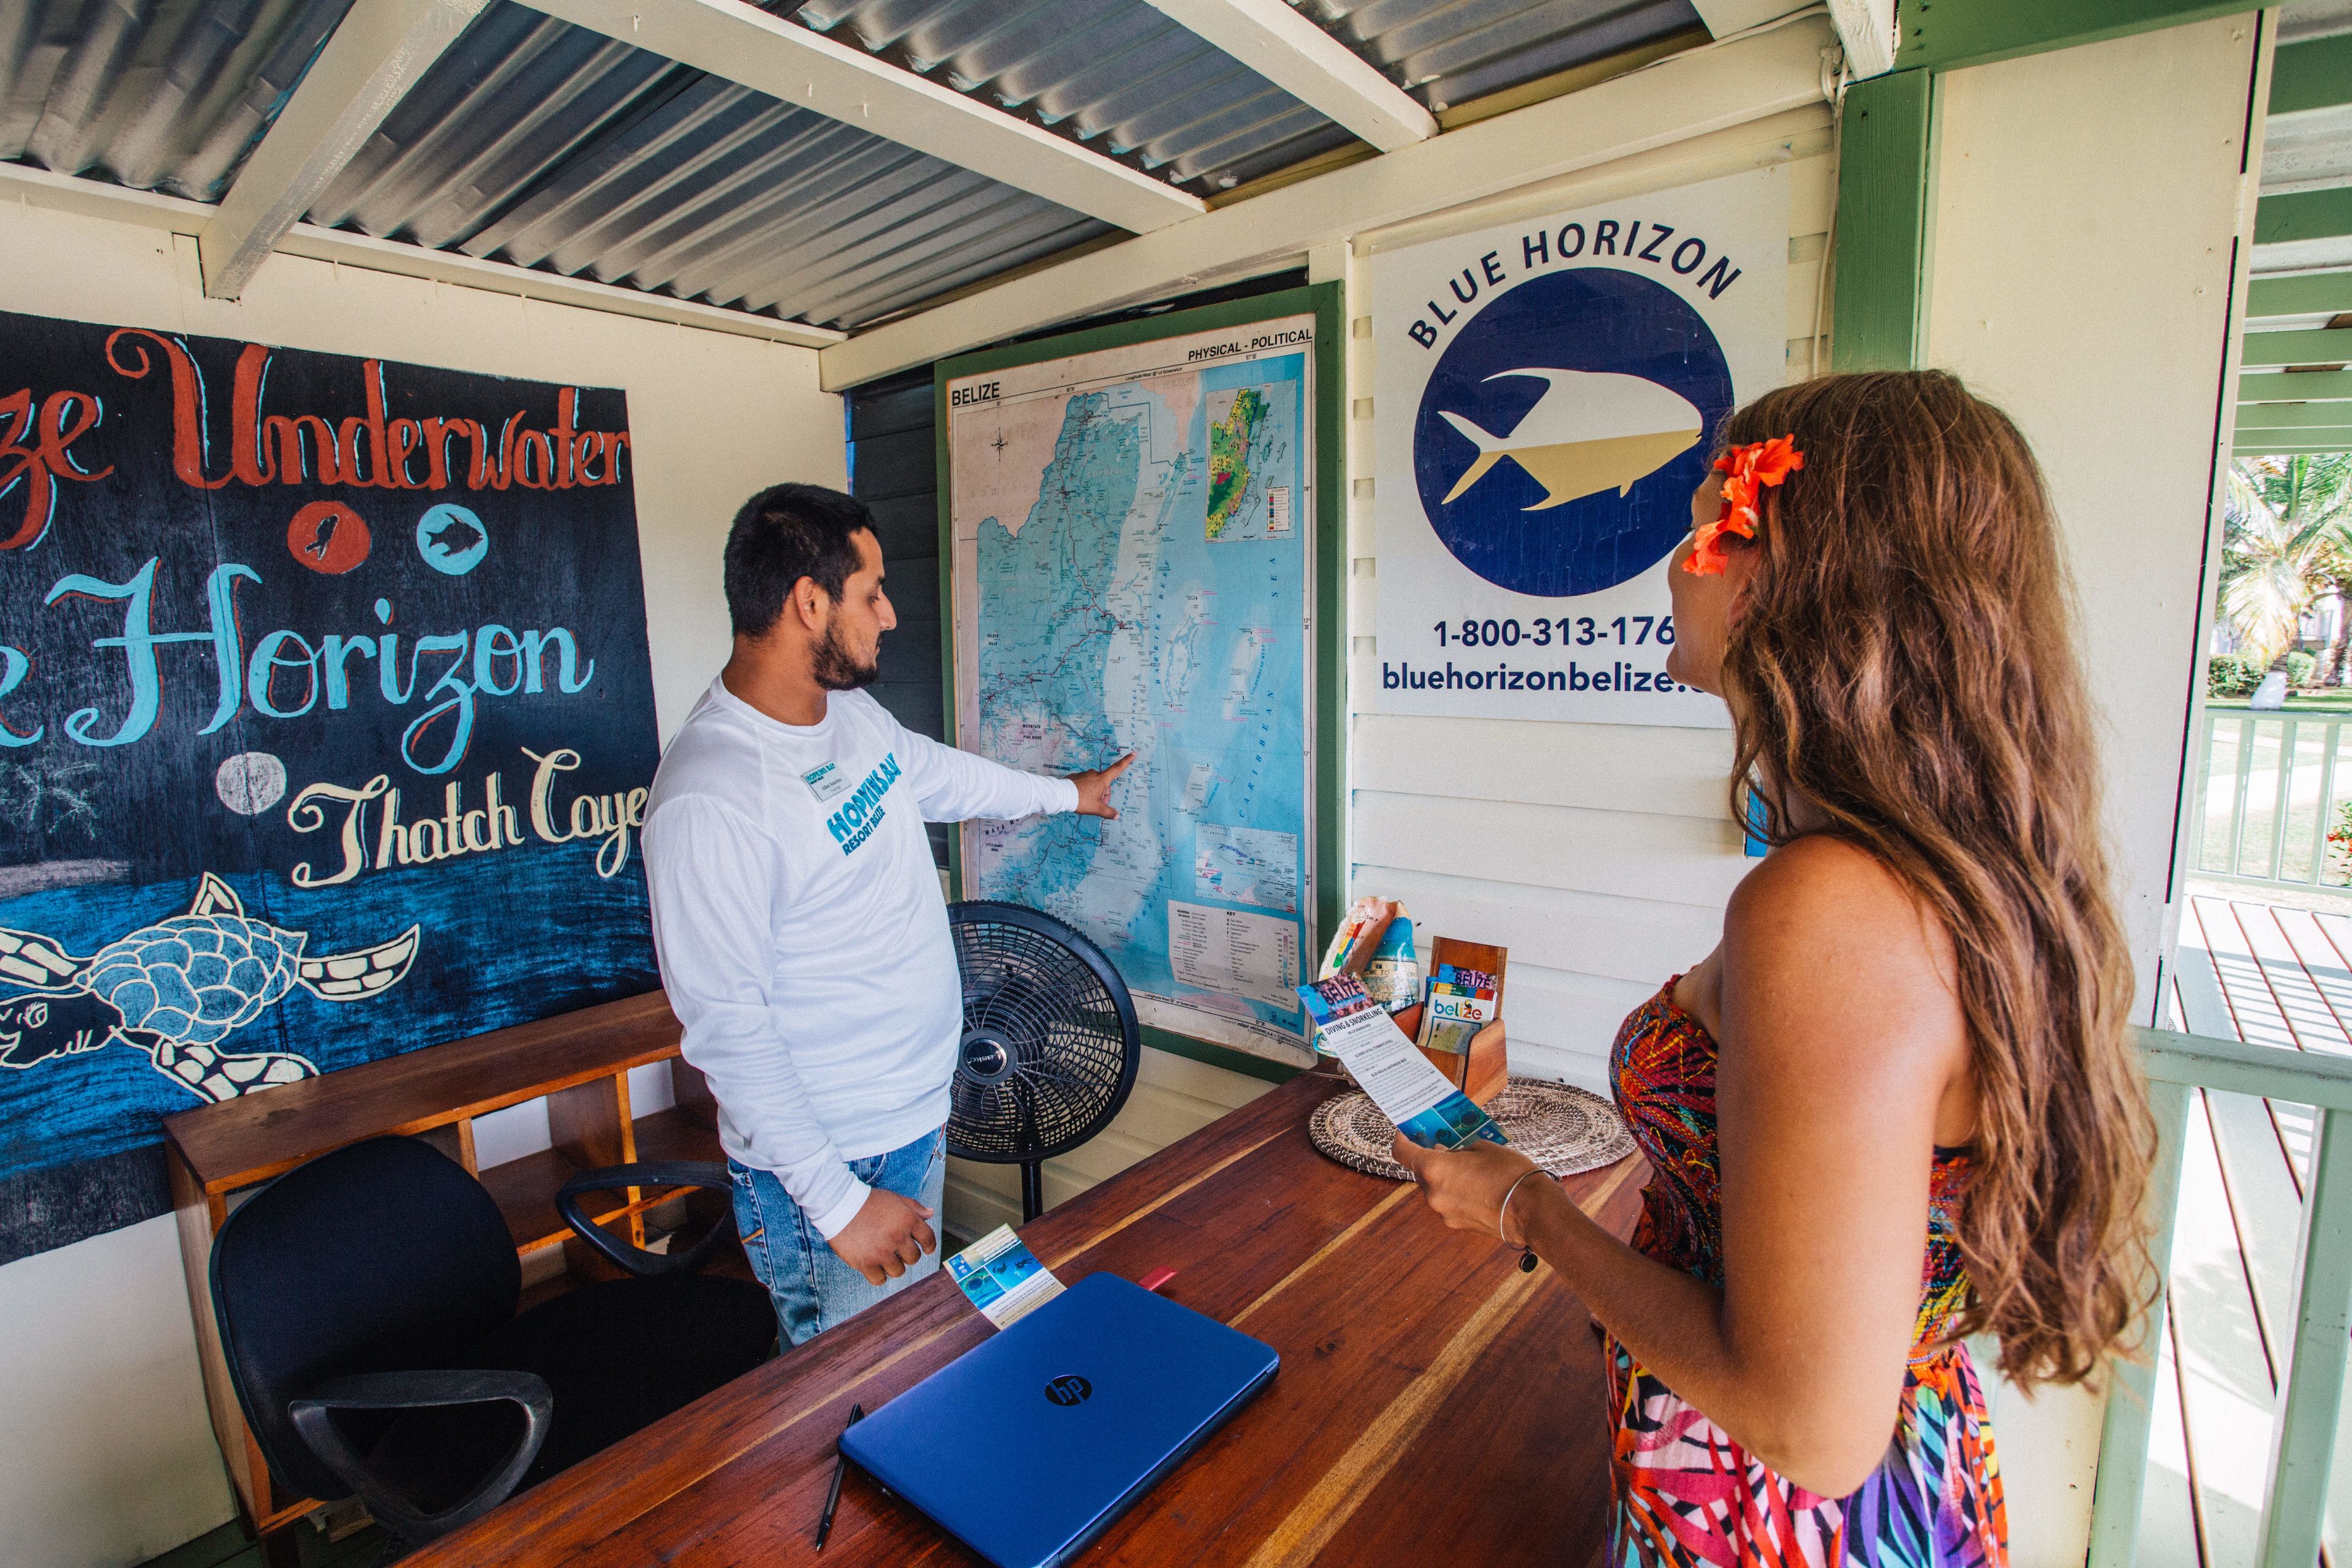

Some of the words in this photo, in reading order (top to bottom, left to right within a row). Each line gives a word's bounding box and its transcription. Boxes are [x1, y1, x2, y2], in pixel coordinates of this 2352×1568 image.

[1408, 251, 1506, 350] BLUE
[1522, 219, 1742, 300] HORIZON
[1188, 343, 1242, 361] PHYSICAL
[1251, 329, 1313, 349] POLITICAL
[105, 328, 630, 490] Underwater
[952, 382, 1000, 406] BELIZE
[45, 556, 594, 774] Horizon
[1382, 662, 1706, 693] bluehorizonbelize.
[1238, 690, 1275, 819] CARIBBEAN
[1268, 557, 1279, 598] SEA
[288, 774, 521, 888] Thatch
[521, 746, 647, 878] Caye
[826, 769, 889, 843] HOPKINS
[878, 752, 902, 785] BAY
[842, 821, 874, 856] RESORT
[871, 805, 886, 829] BELIZE
[1320, 980, 1365, 1005] BELIZE
[1434, 999, 1482, 1020] belize
[1325, 1022, 1346, 1035] DIVING
[1349, 1008, 1383, 1025] SNORKELING
[1048, 1377, 1084, 1404] hp
